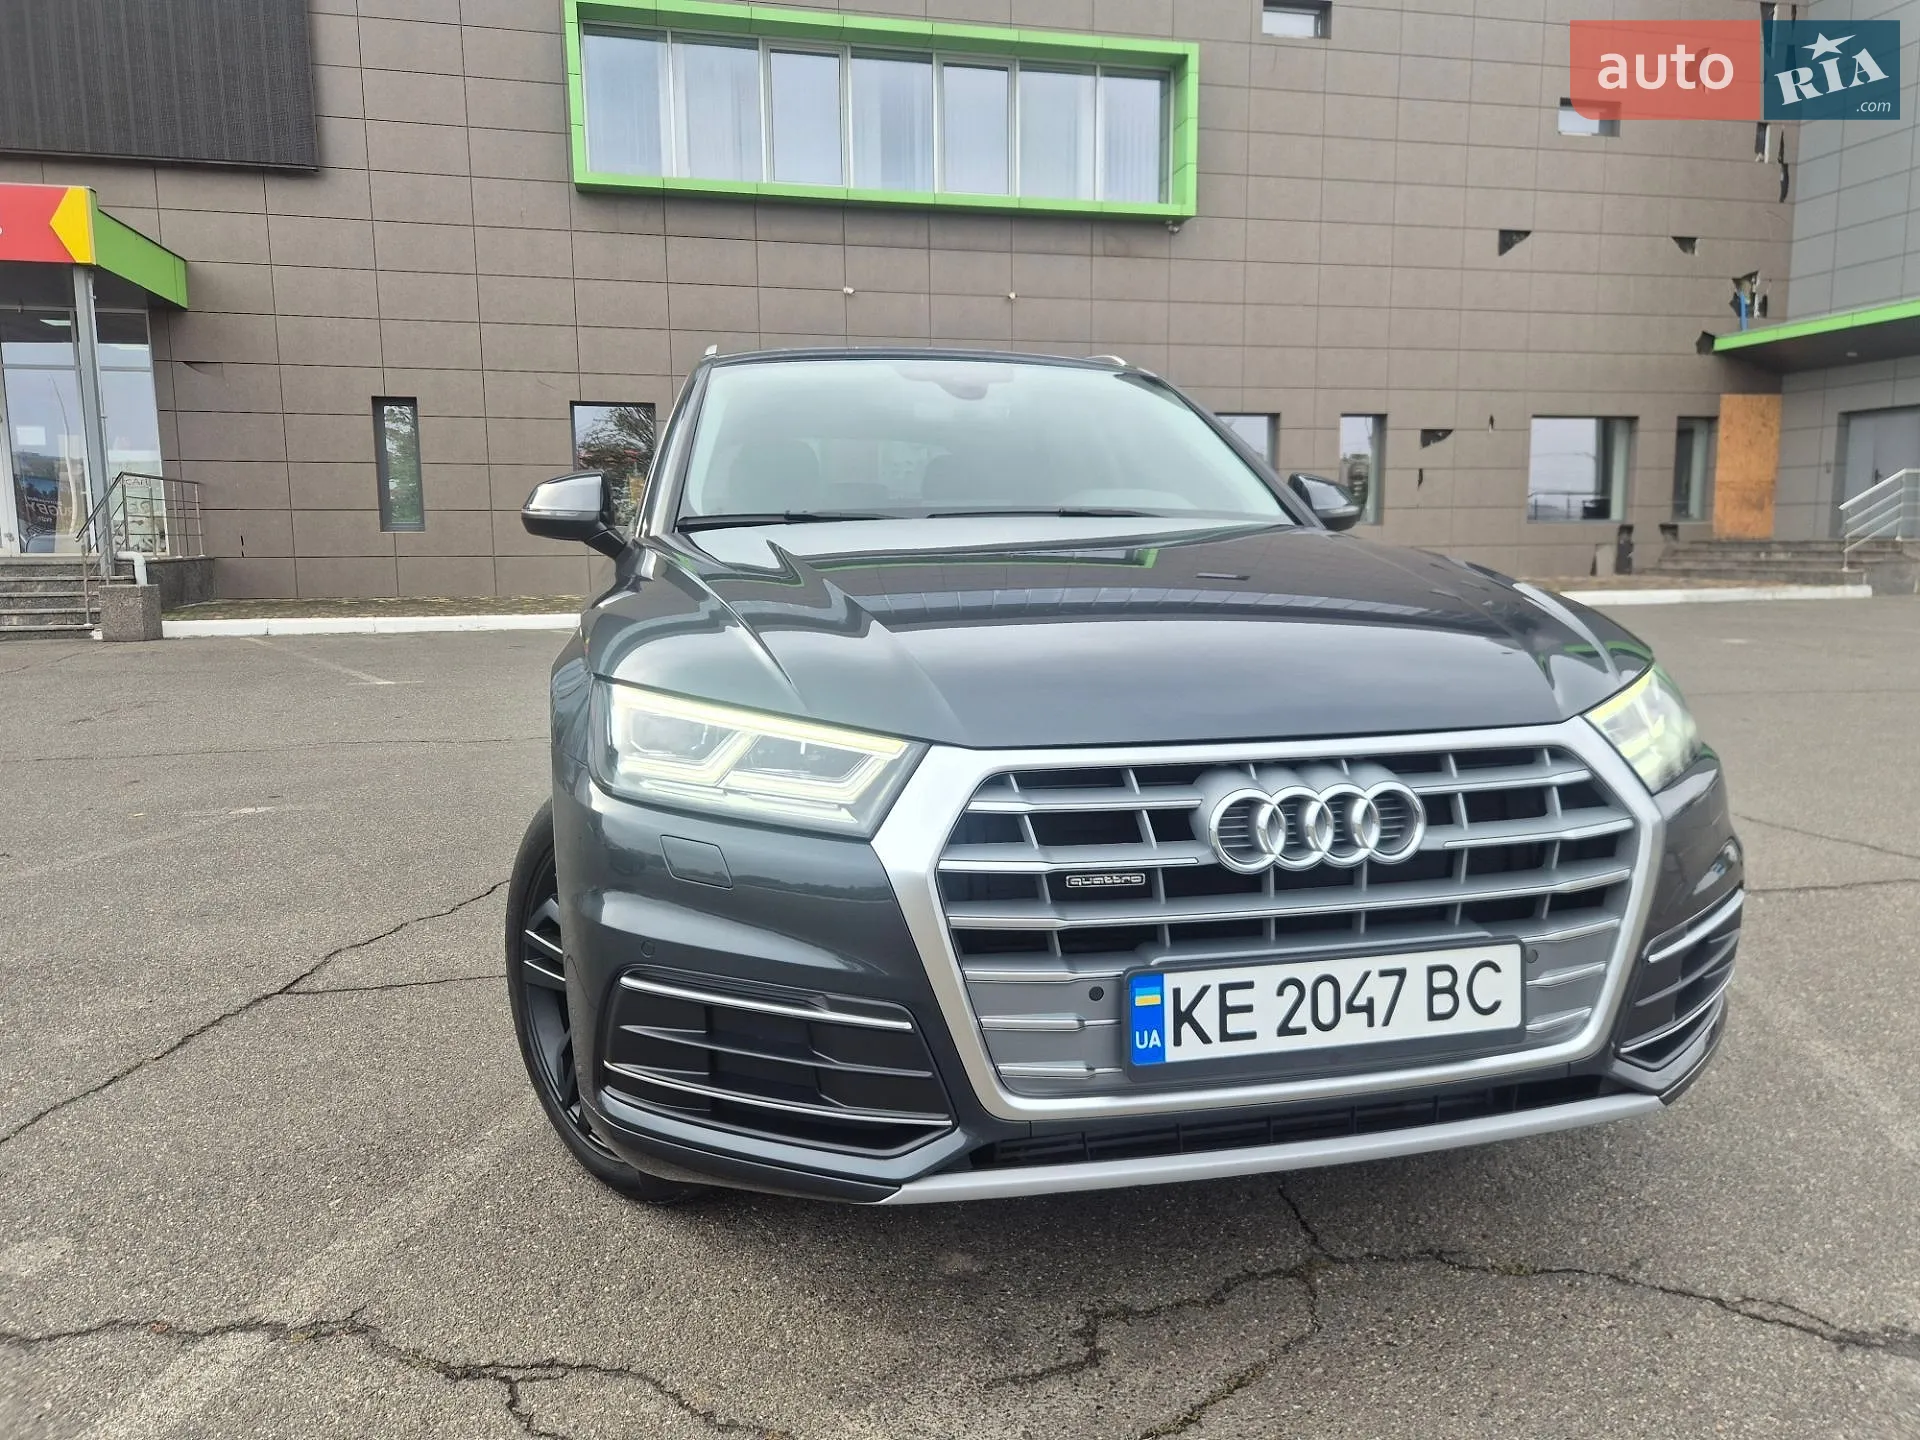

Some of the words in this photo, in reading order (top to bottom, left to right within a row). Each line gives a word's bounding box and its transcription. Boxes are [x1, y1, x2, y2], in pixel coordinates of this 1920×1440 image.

[1070, 876, 1141, 886] quattro
[1172, 980, 1258, 1047] KE
[1275, 967, 1407, 1037] 2047
[1426, 959, 1502, 1022] BC
[1135, 1029, 1162, 1050] UA
